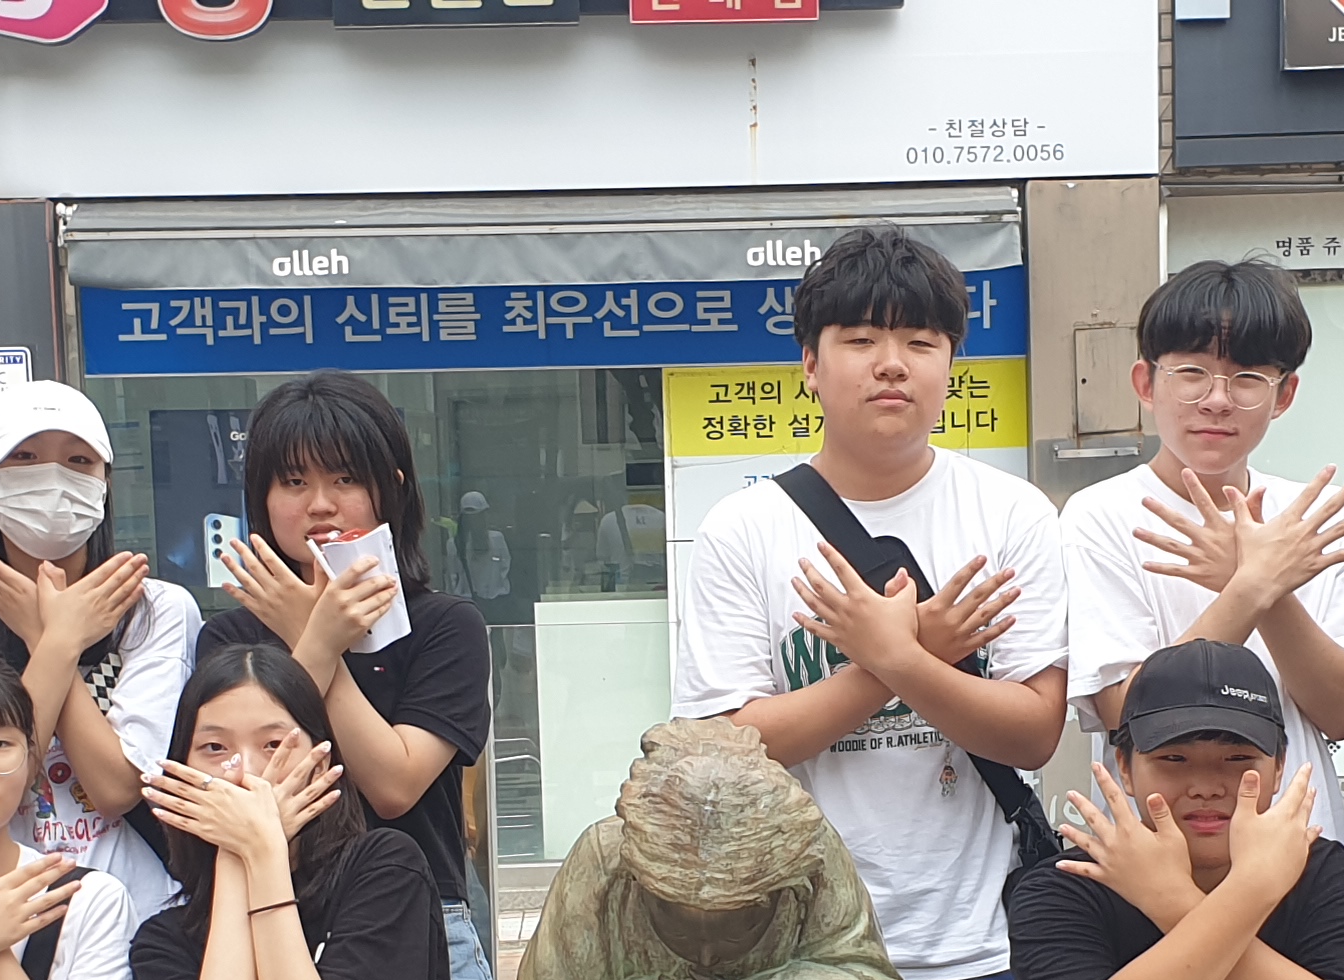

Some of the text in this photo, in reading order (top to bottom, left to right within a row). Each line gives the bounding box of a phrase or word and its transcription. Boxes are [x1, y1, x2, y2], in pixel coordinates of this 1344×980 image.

[945, 117, 1029, 138] 친절상담
[906, 144, 1065, 164] 010.7572.0056
[746, 240, 822, 266] olleh
[1275, 236, 1315, 258] 명품
[273, 248, 350, 278] olleh
[118, 294, 314, 346] 고객과의
[335, 291, 482, 342] 신뢰를
[502, 288, 739, 340] 최우선으로
[708, 380, 782, 405] 고객의
[702, 414, 776, 440] 정확한
[1221, 685, 1250, 700] Jeep
[870, 738, 883, 750] OF
